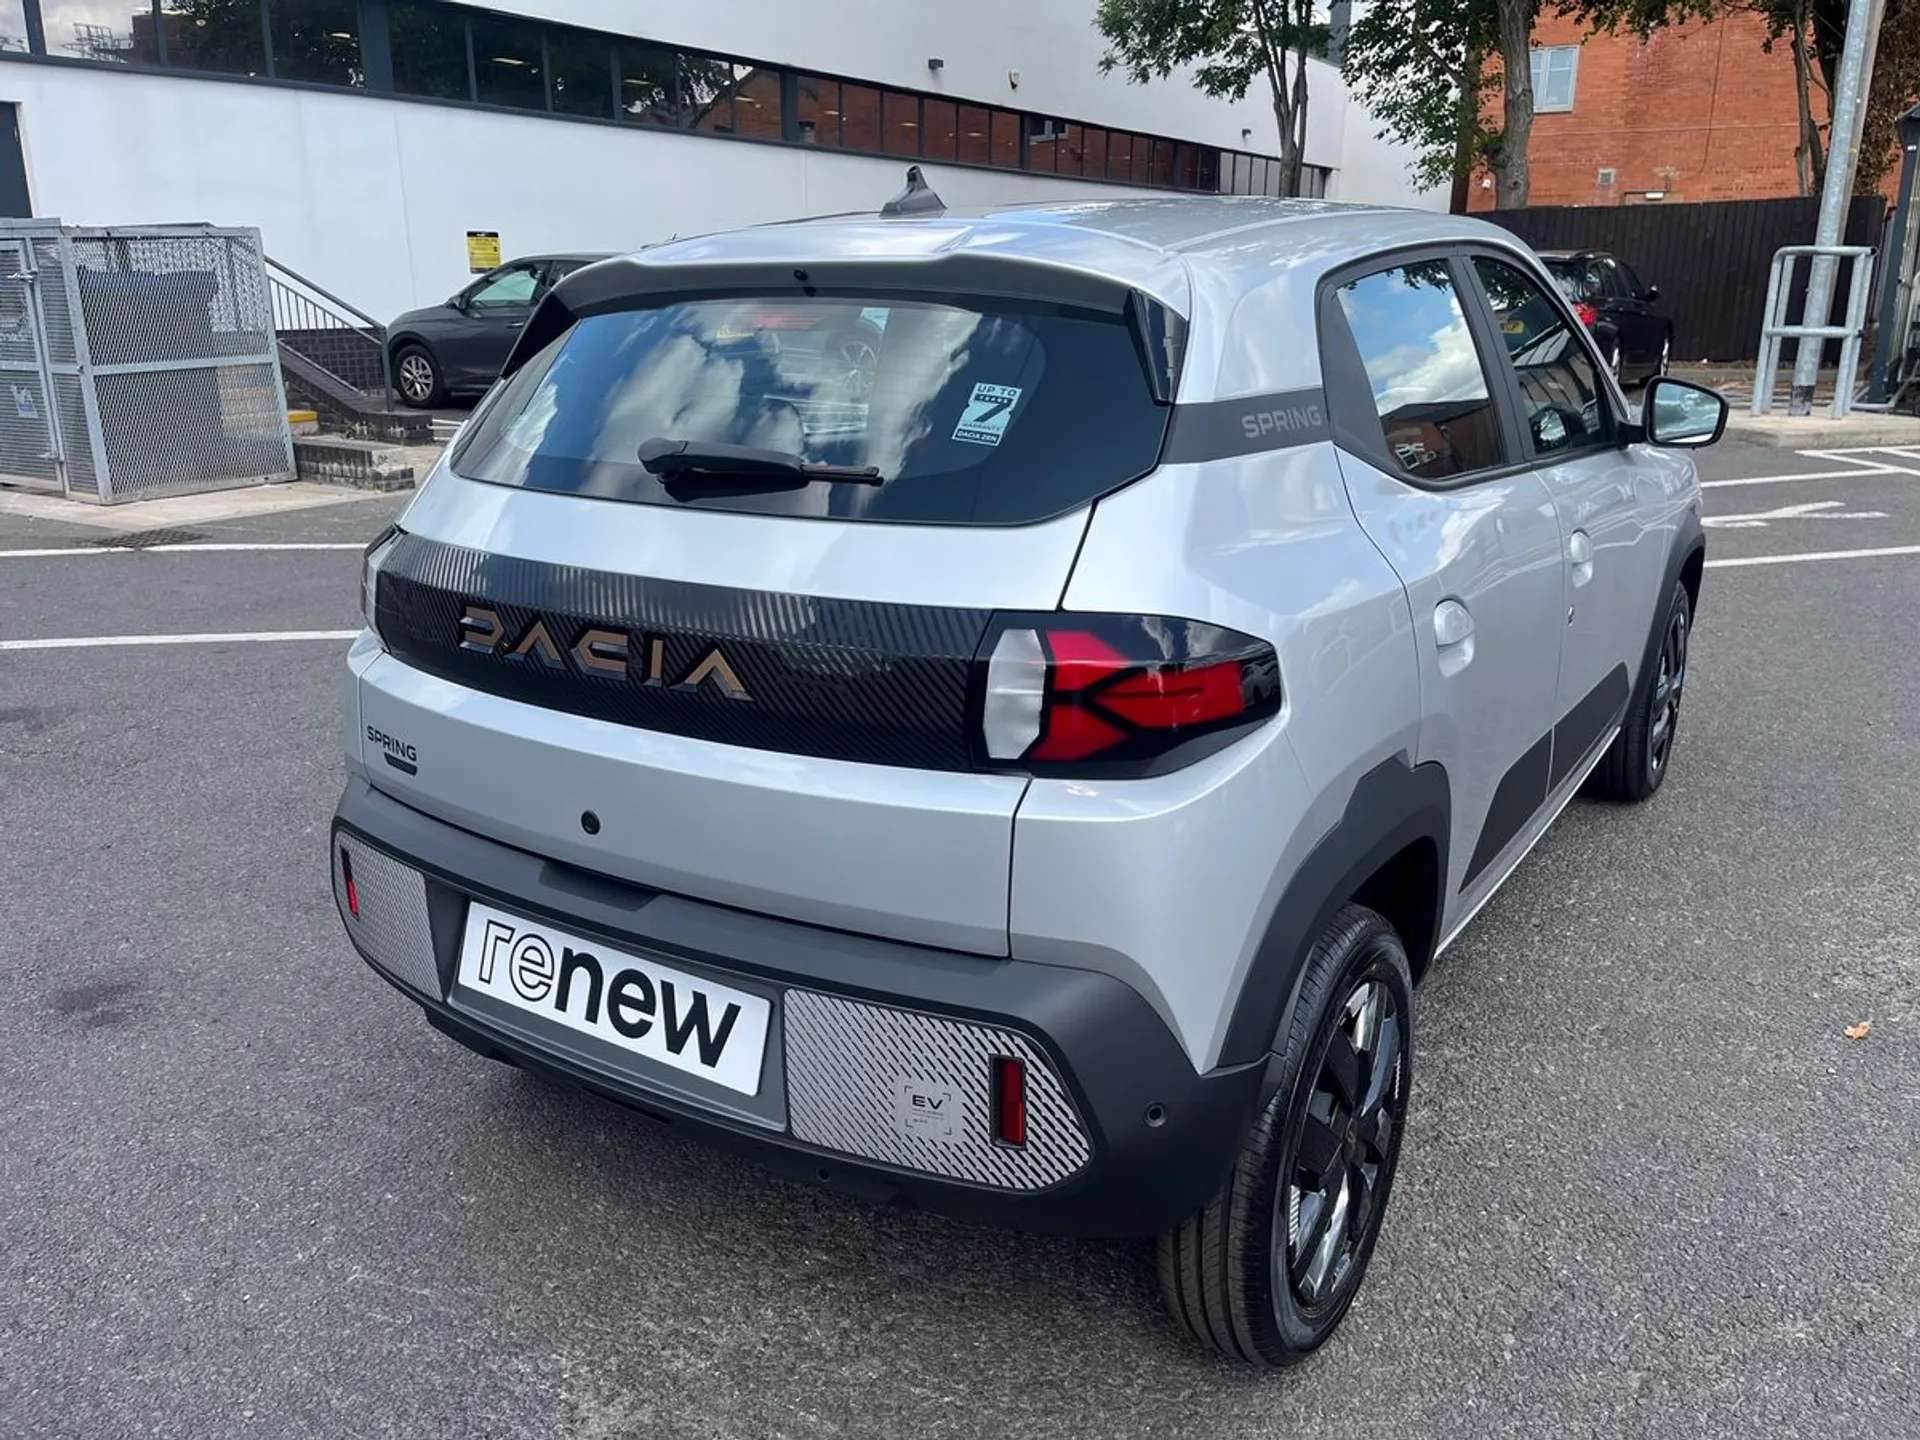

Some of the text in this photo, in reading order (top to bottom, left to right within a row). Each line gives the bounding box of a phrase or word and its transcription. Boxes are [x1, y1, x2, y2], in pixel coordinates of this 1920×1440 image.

[977, 385, 1017, 396] UP TO
[973, 394, 1014, 423] 7
[1241, 405, 1322, 438] SPRING
[459, 605, 754, 701] DACIA
[367, 725, 417, 762] SPRING
[479, 918, 742, 1069] renew
[912, 1094, 943, 1110] EV
